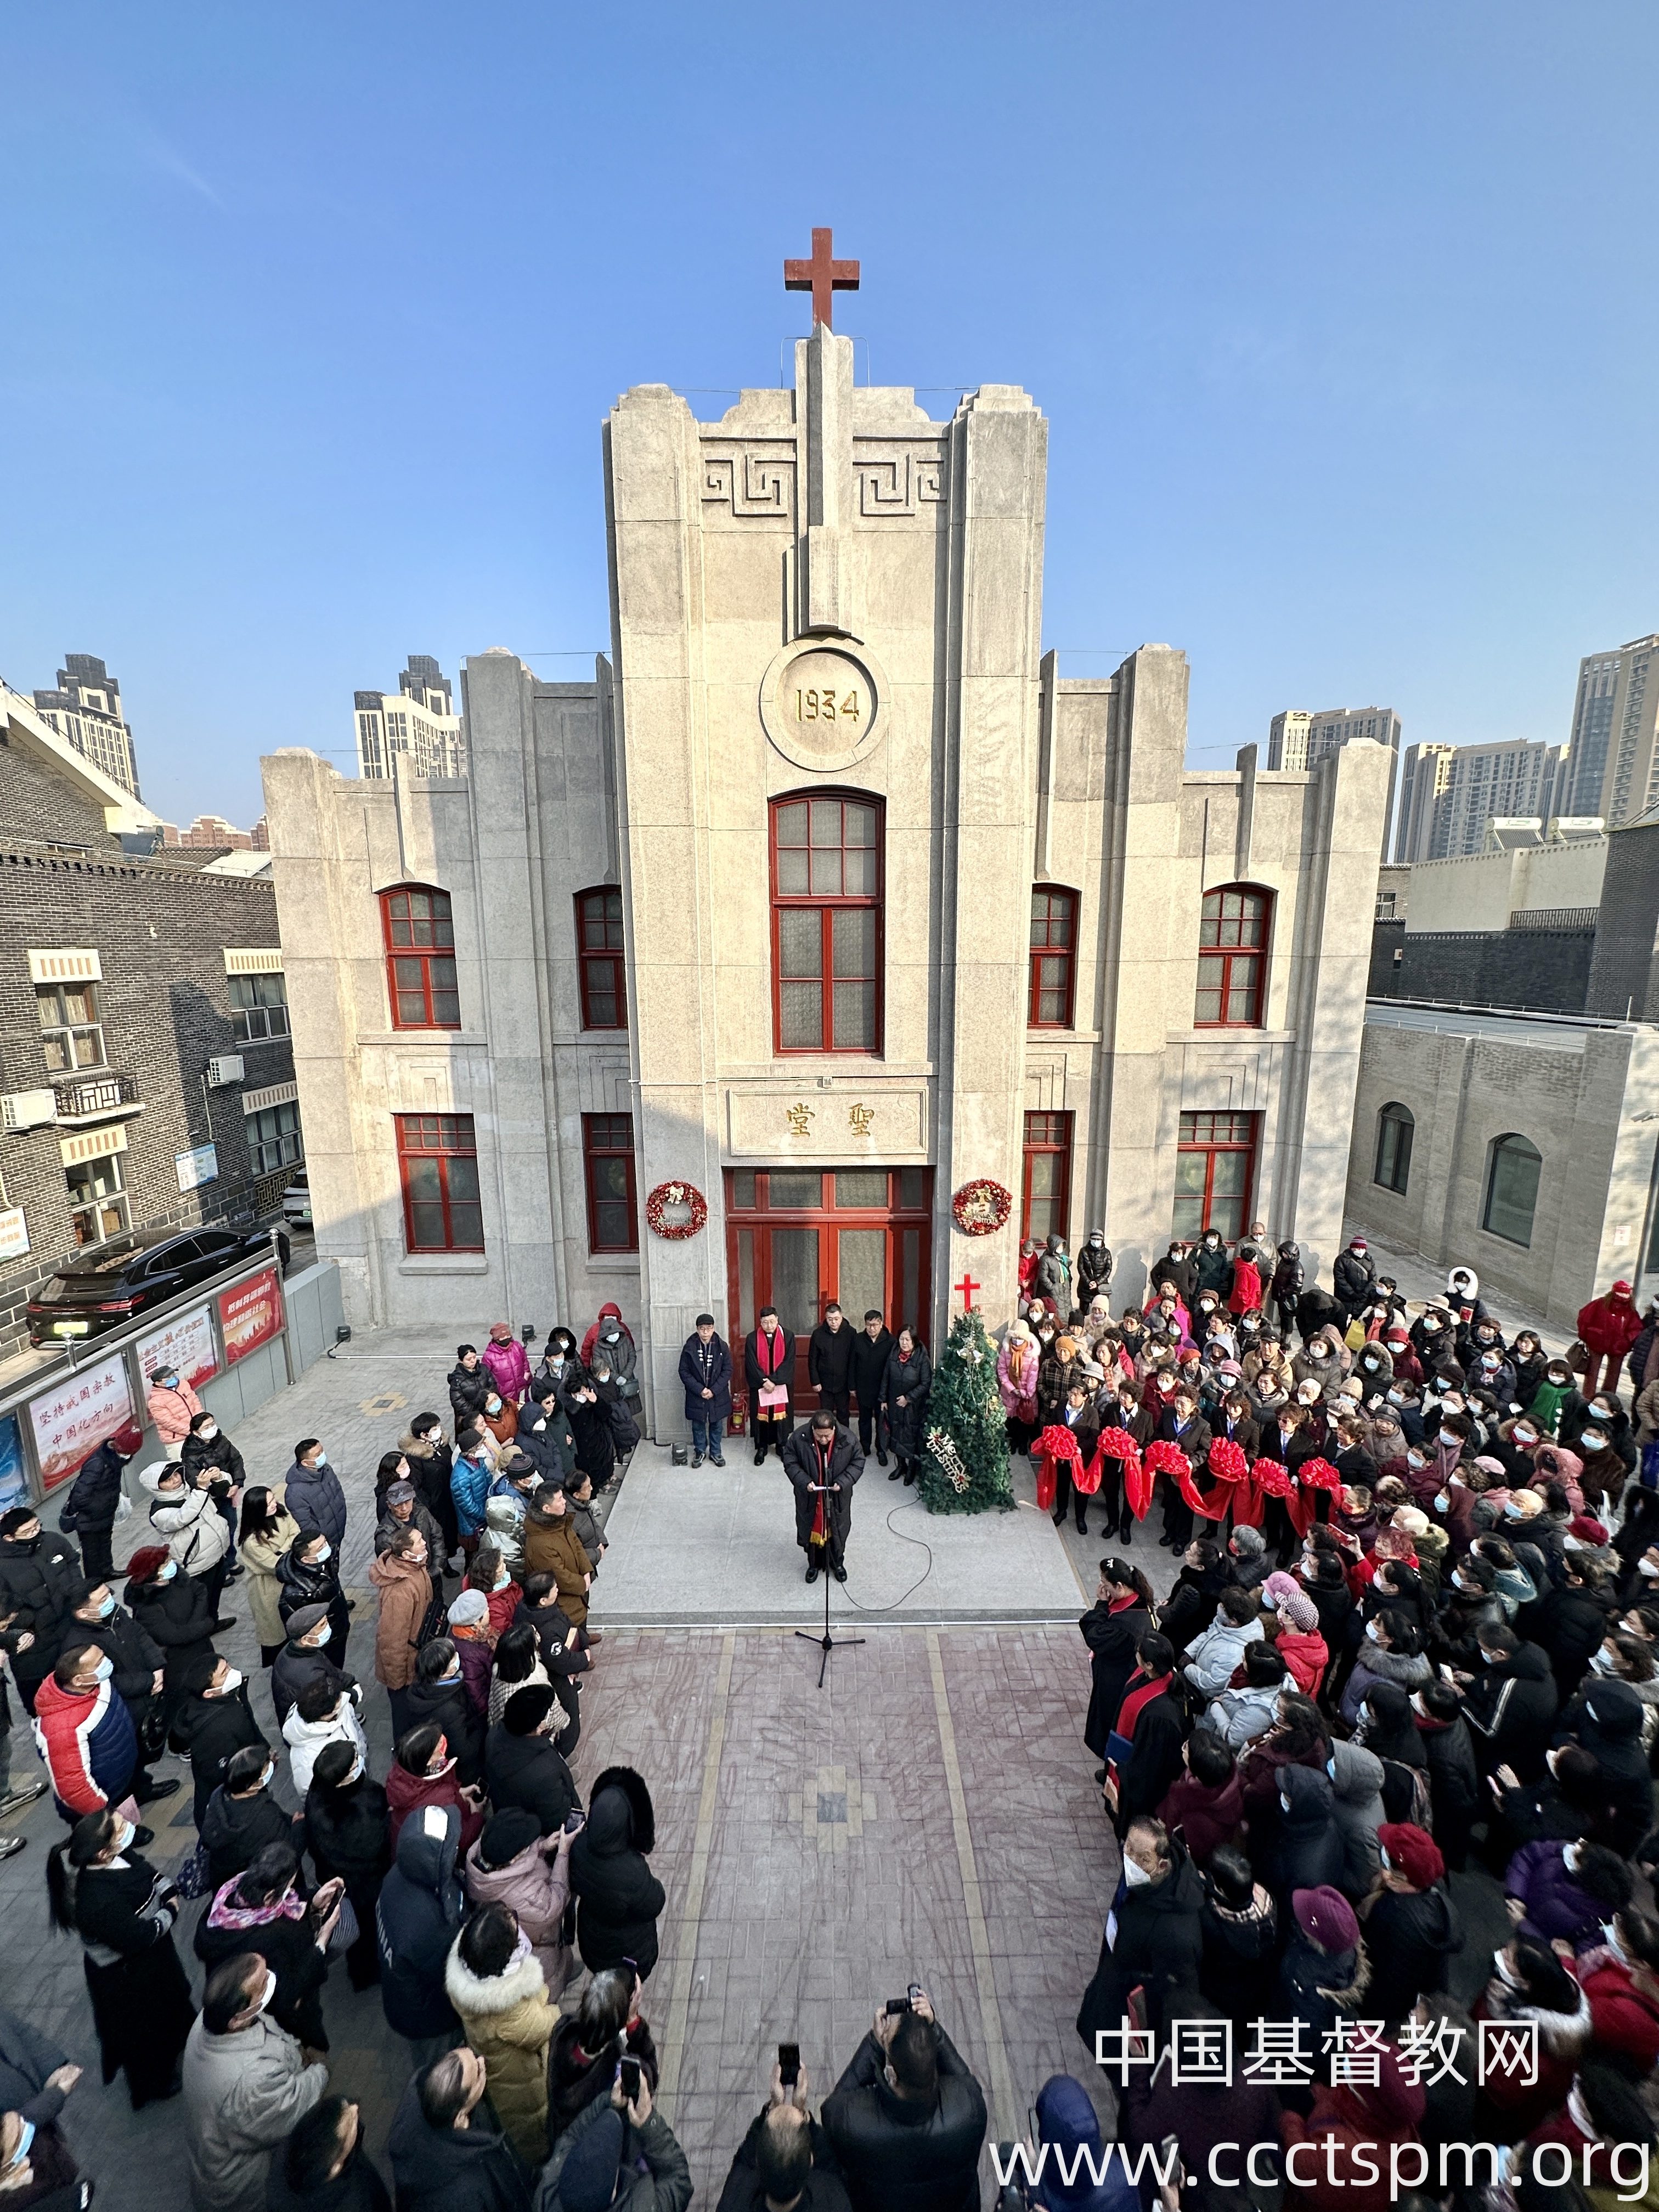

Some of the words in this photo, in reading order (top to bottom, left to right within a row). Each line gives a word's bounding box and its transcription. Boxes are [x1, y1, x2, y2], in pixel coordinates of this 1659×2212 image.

[796, 689, 859, 723] 1934
[40, 1373, 115, 1427] 坚持我国宗教
[52, 1403, 113, 1449] 中国化方向
